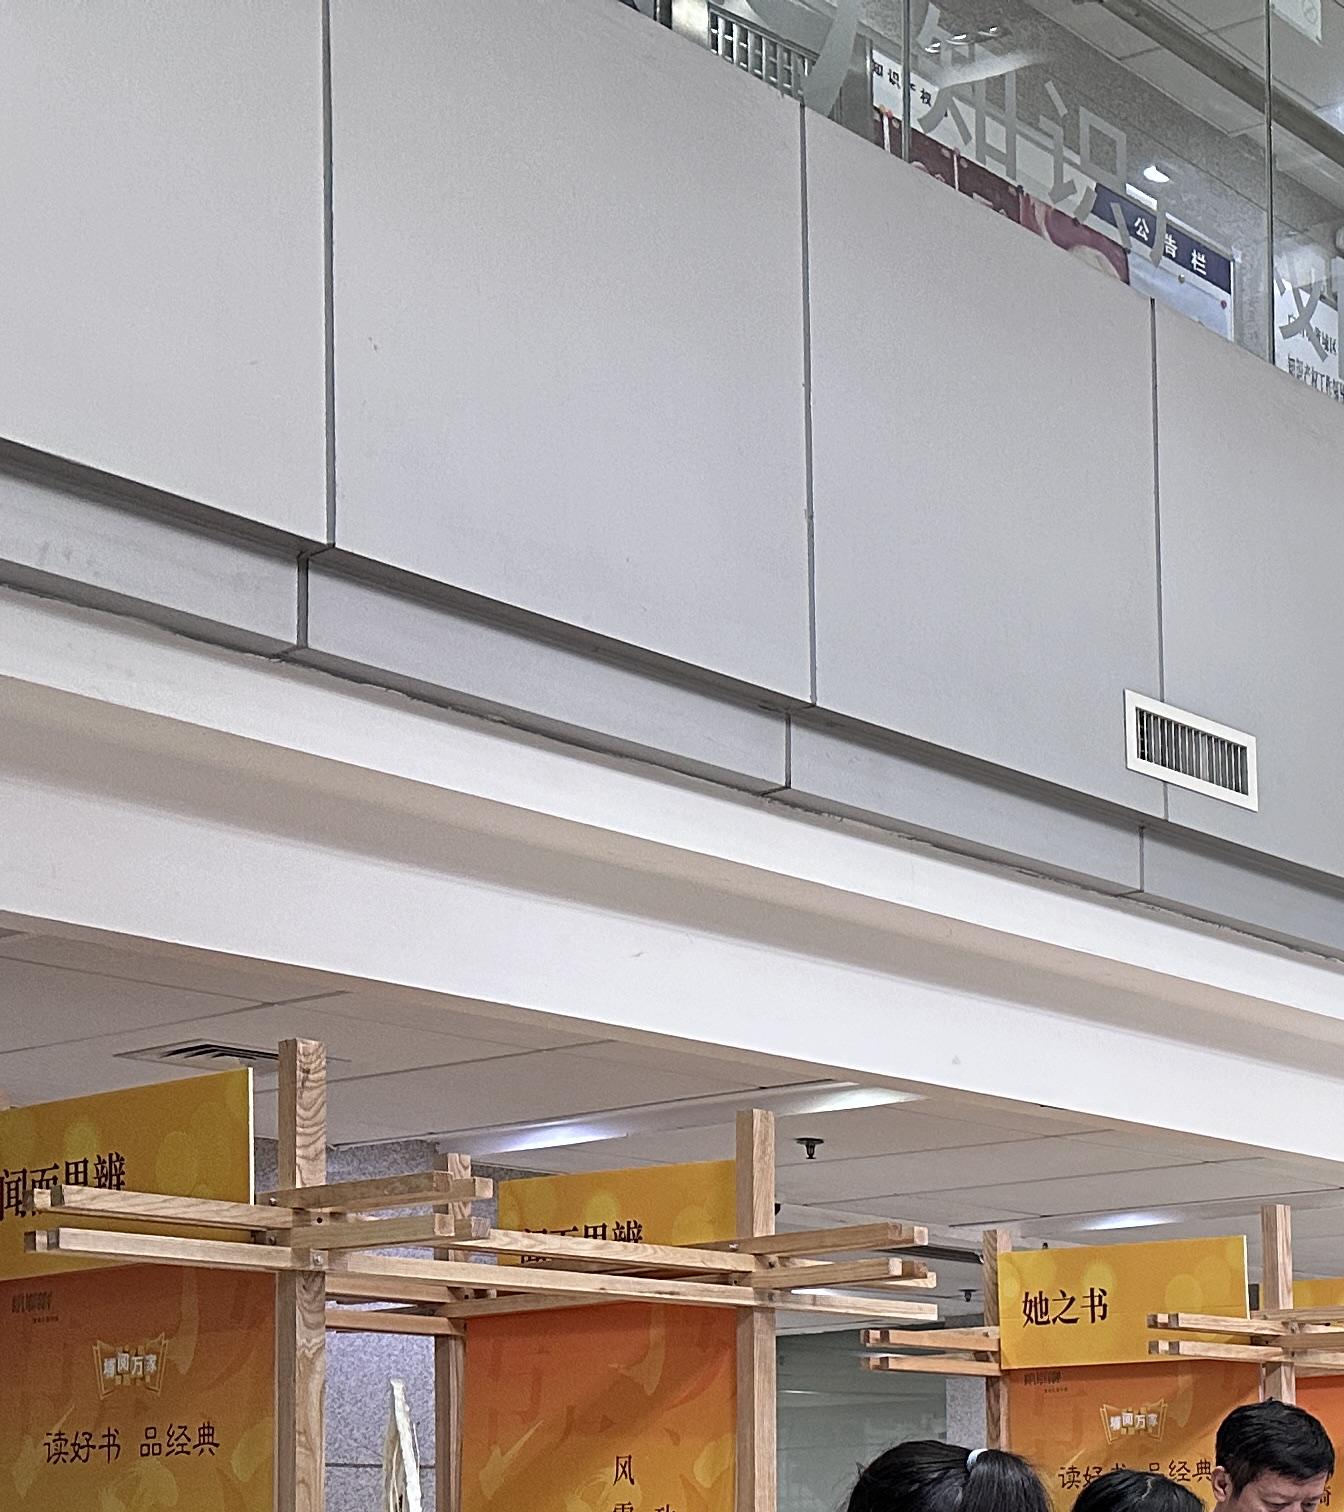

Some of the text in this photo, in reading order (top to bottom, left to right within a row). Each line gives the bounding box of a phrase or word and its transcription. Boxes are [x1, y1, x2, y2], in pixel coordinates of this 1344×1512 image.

[1134, 215, 1208, 276] 公告栏
[1021, 1287, 1109, 1328] 她之书
[43, 1421, 220, 1465] 读好书 品经典
